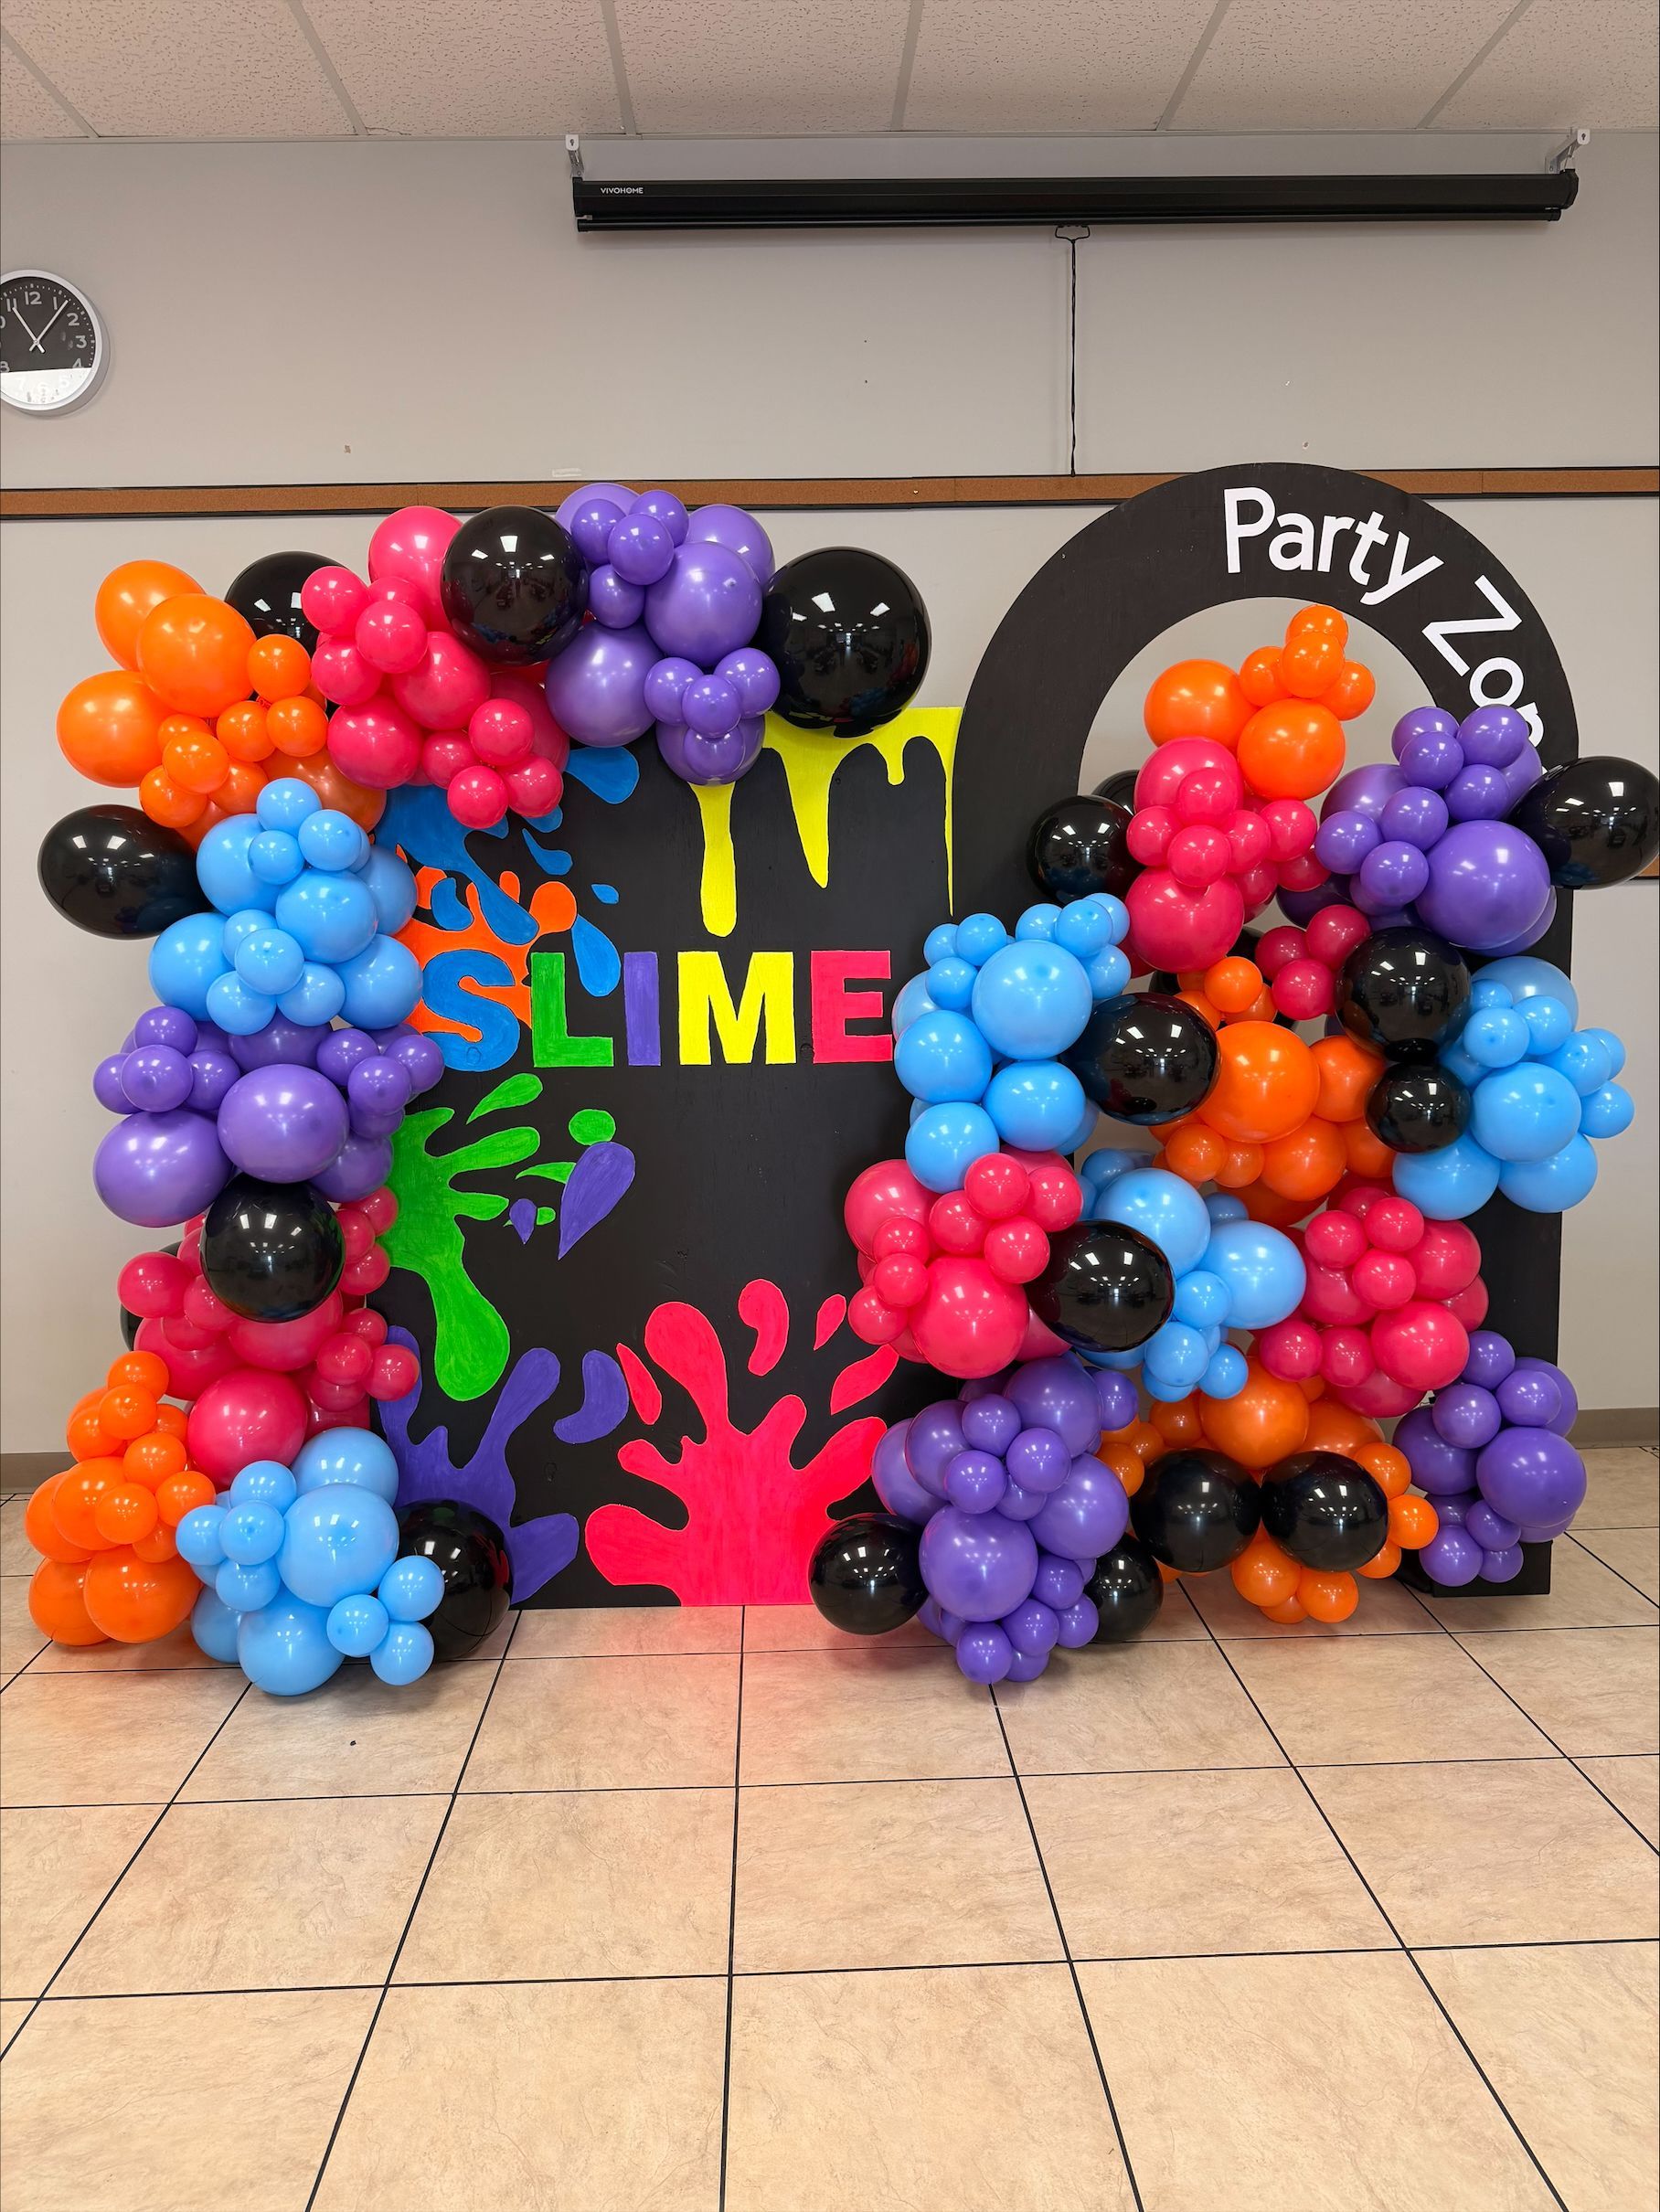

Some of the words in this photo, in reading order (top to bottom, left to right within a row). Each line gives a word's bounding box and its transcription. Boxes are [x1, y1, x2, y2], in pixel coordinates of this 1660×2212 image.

[600, 186, 644, 195] VIVOHOME
[6, 298, 17, 312] 11
[25, 291, 42, 305] 12
[53, 296, 58, 311] 1
[67, 312, 80, 326] 2
[75, 335, 88, 349] 3
[1223, 486, 1445, 606] Party
[422, 949, 893, 1072] SLIME
